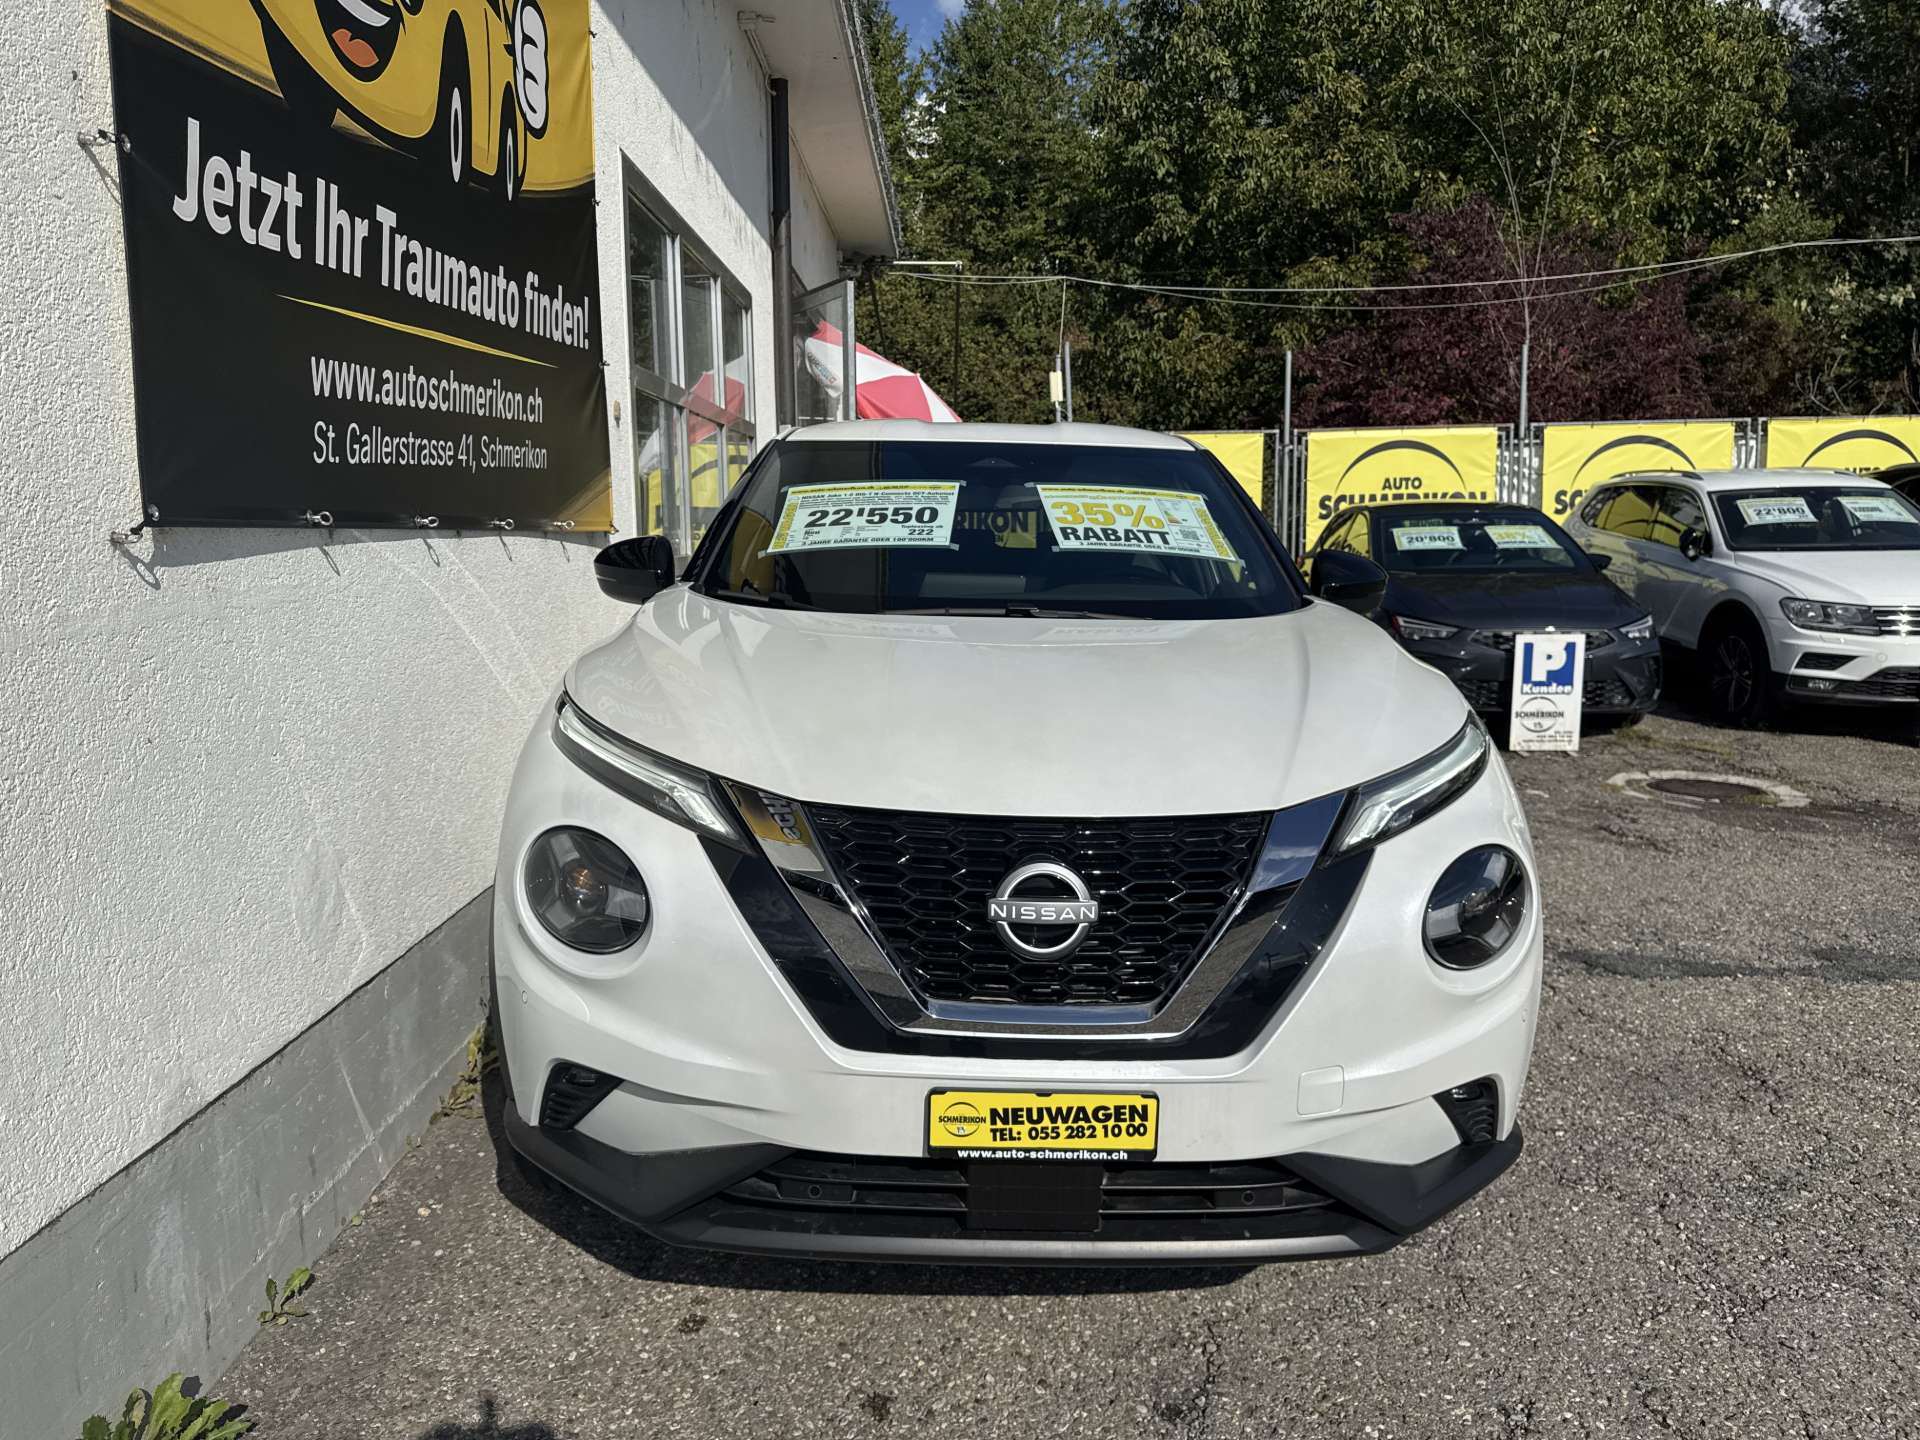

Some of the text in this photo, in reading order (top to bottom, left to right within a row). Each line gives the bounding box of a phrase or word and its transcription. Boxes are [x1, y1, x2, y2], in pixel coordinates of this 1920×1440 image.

[172, 116, 589, 350] Jetzt Ihr Traumauto finden!
[310, 356, 543, 423] www.autoschmerikon.ch
[313, 420, 548, 474] St. Gallerstrasse 41, Schmerikon
[1382, 476, 1423, 490] AUTO
[804, 506, 939, 528] 22'550
[1051, 501, 1165, 530] 35%
[907, 528, 934, 536] 222
[1059, 526, 1170, 545] RABATT
[1531, 641, 1567, 682] P
[1522, 682, 1572, 694] Kunden
[990, 903, 1095, 921] NISSAN
[938, 1104, 1149, 1126] SCHMERIKON NEUWAGEN
[990, 1123, 1148, 1142] TEL: 055 282 10 00
[957, 1149, 1128, 1160] www.auto-schmerikon.ch
